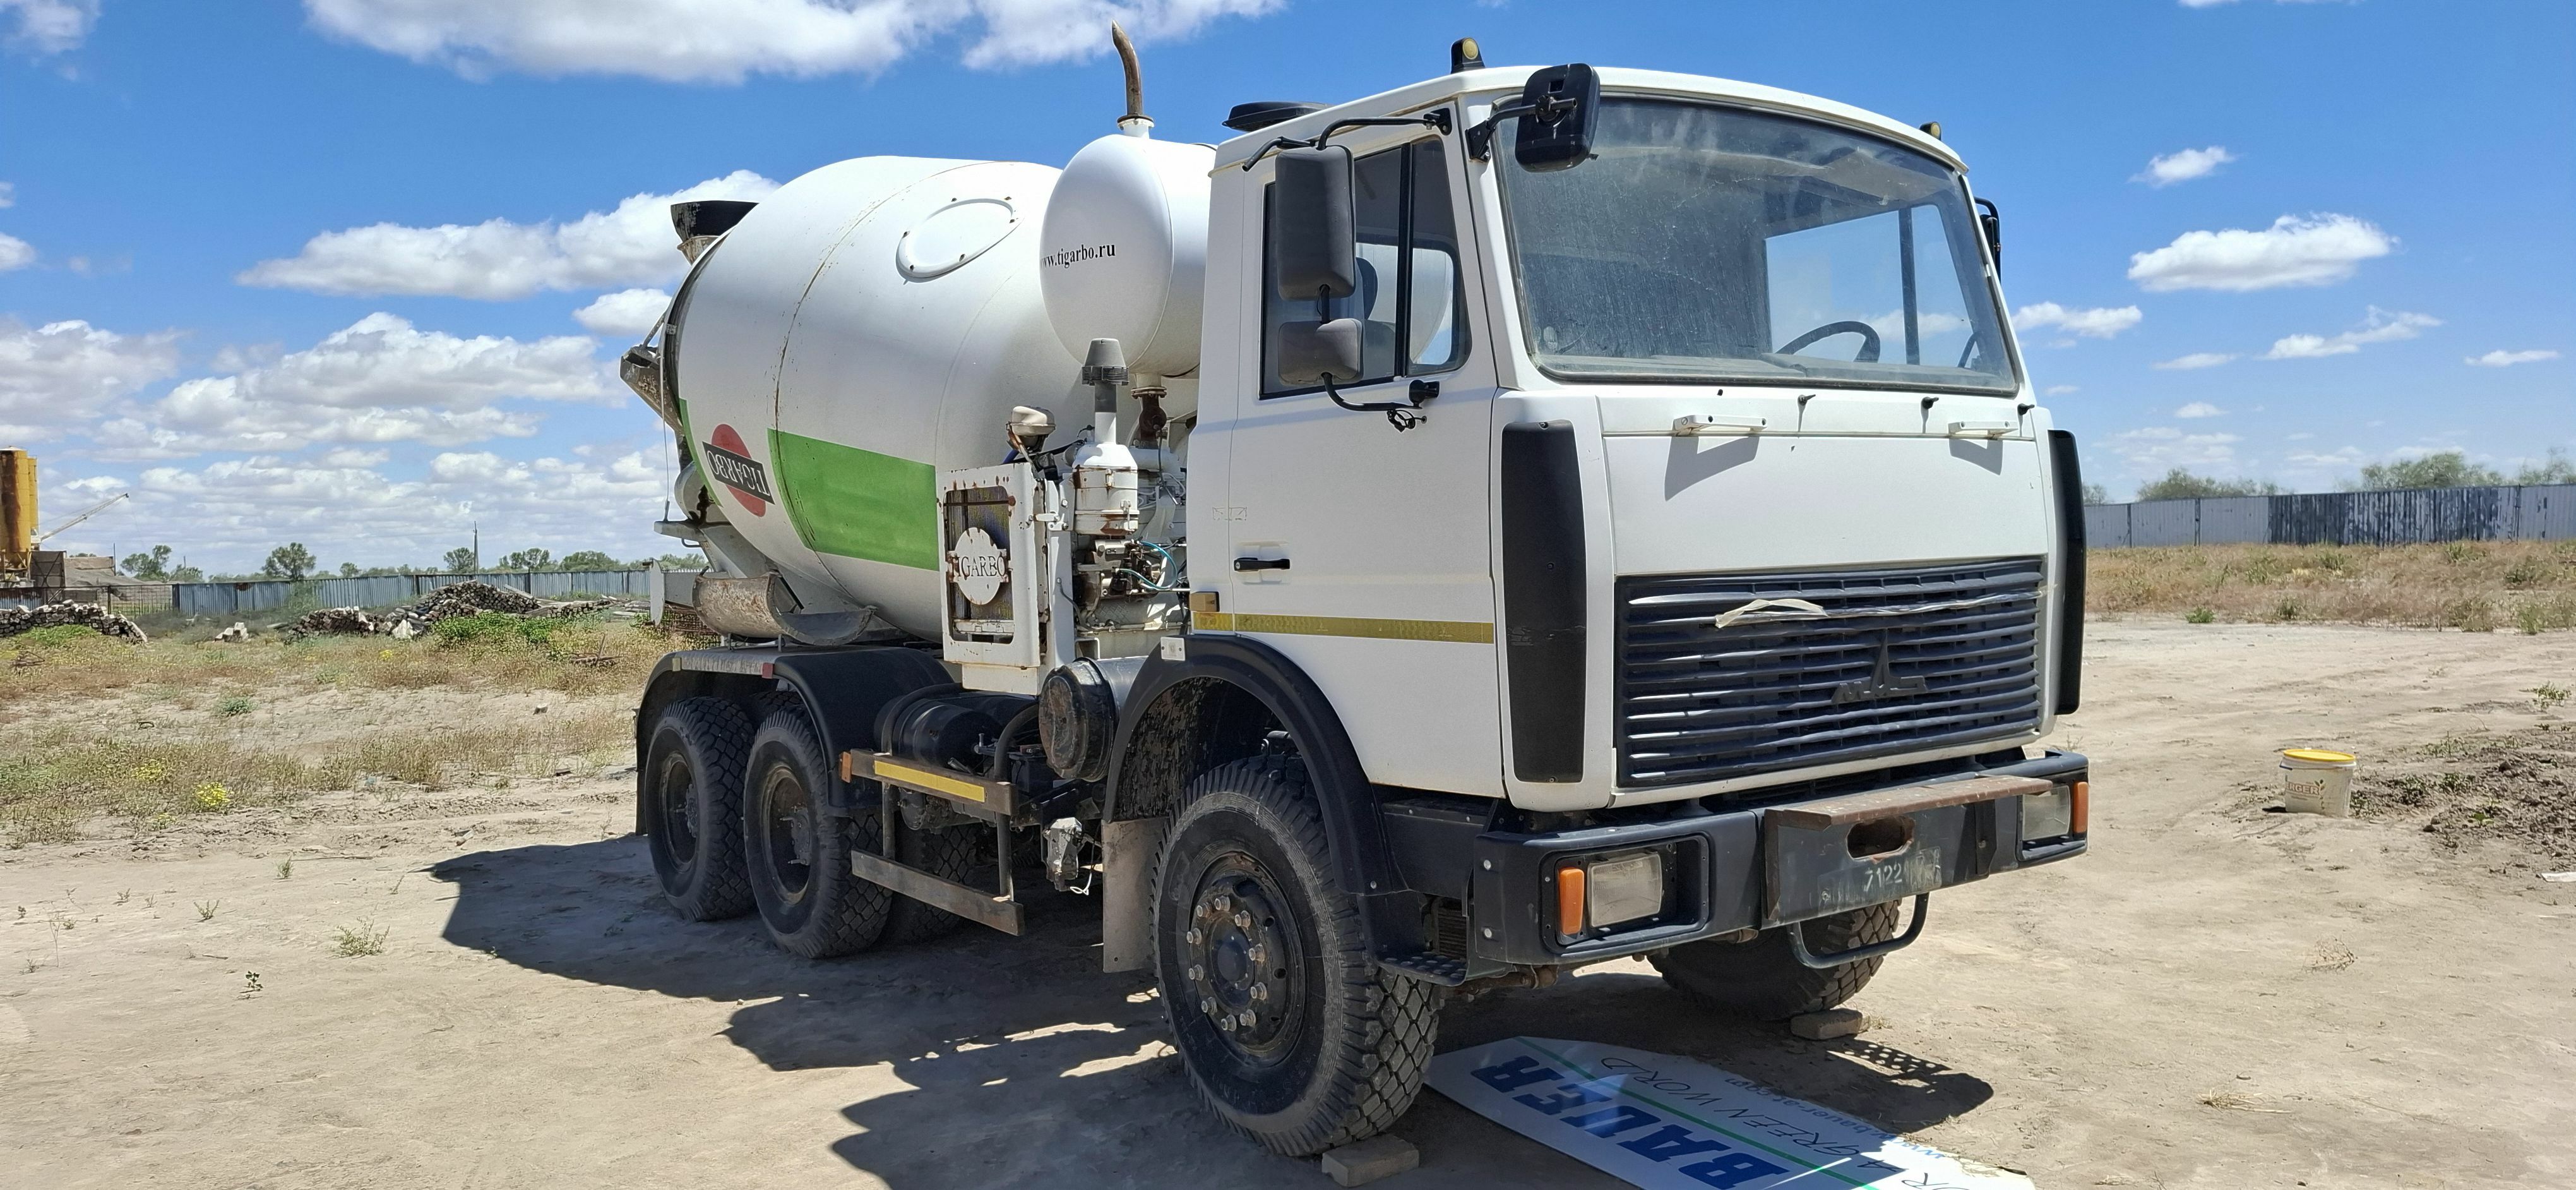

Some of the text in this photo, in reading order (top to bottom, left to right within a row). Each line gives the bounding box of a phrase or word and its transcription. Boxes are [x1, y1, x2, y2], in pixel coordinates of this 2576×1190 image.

[1041, 244, 1116, 269] ww.tigarbo.ru
[707, 450, 770, 496] TIGARBO
[2286, 783, 2318, 794] ERGER
[1601, 1057, 1722, 1105] WORLD
[1470, 1055, 1790, 1190] BAUER
[1714, 1108, 1859, 1156] GREEN
[1724, 1078, 1946, 1159] www.bauer-atcom
[1856, 1159, 1901, 1173] A
